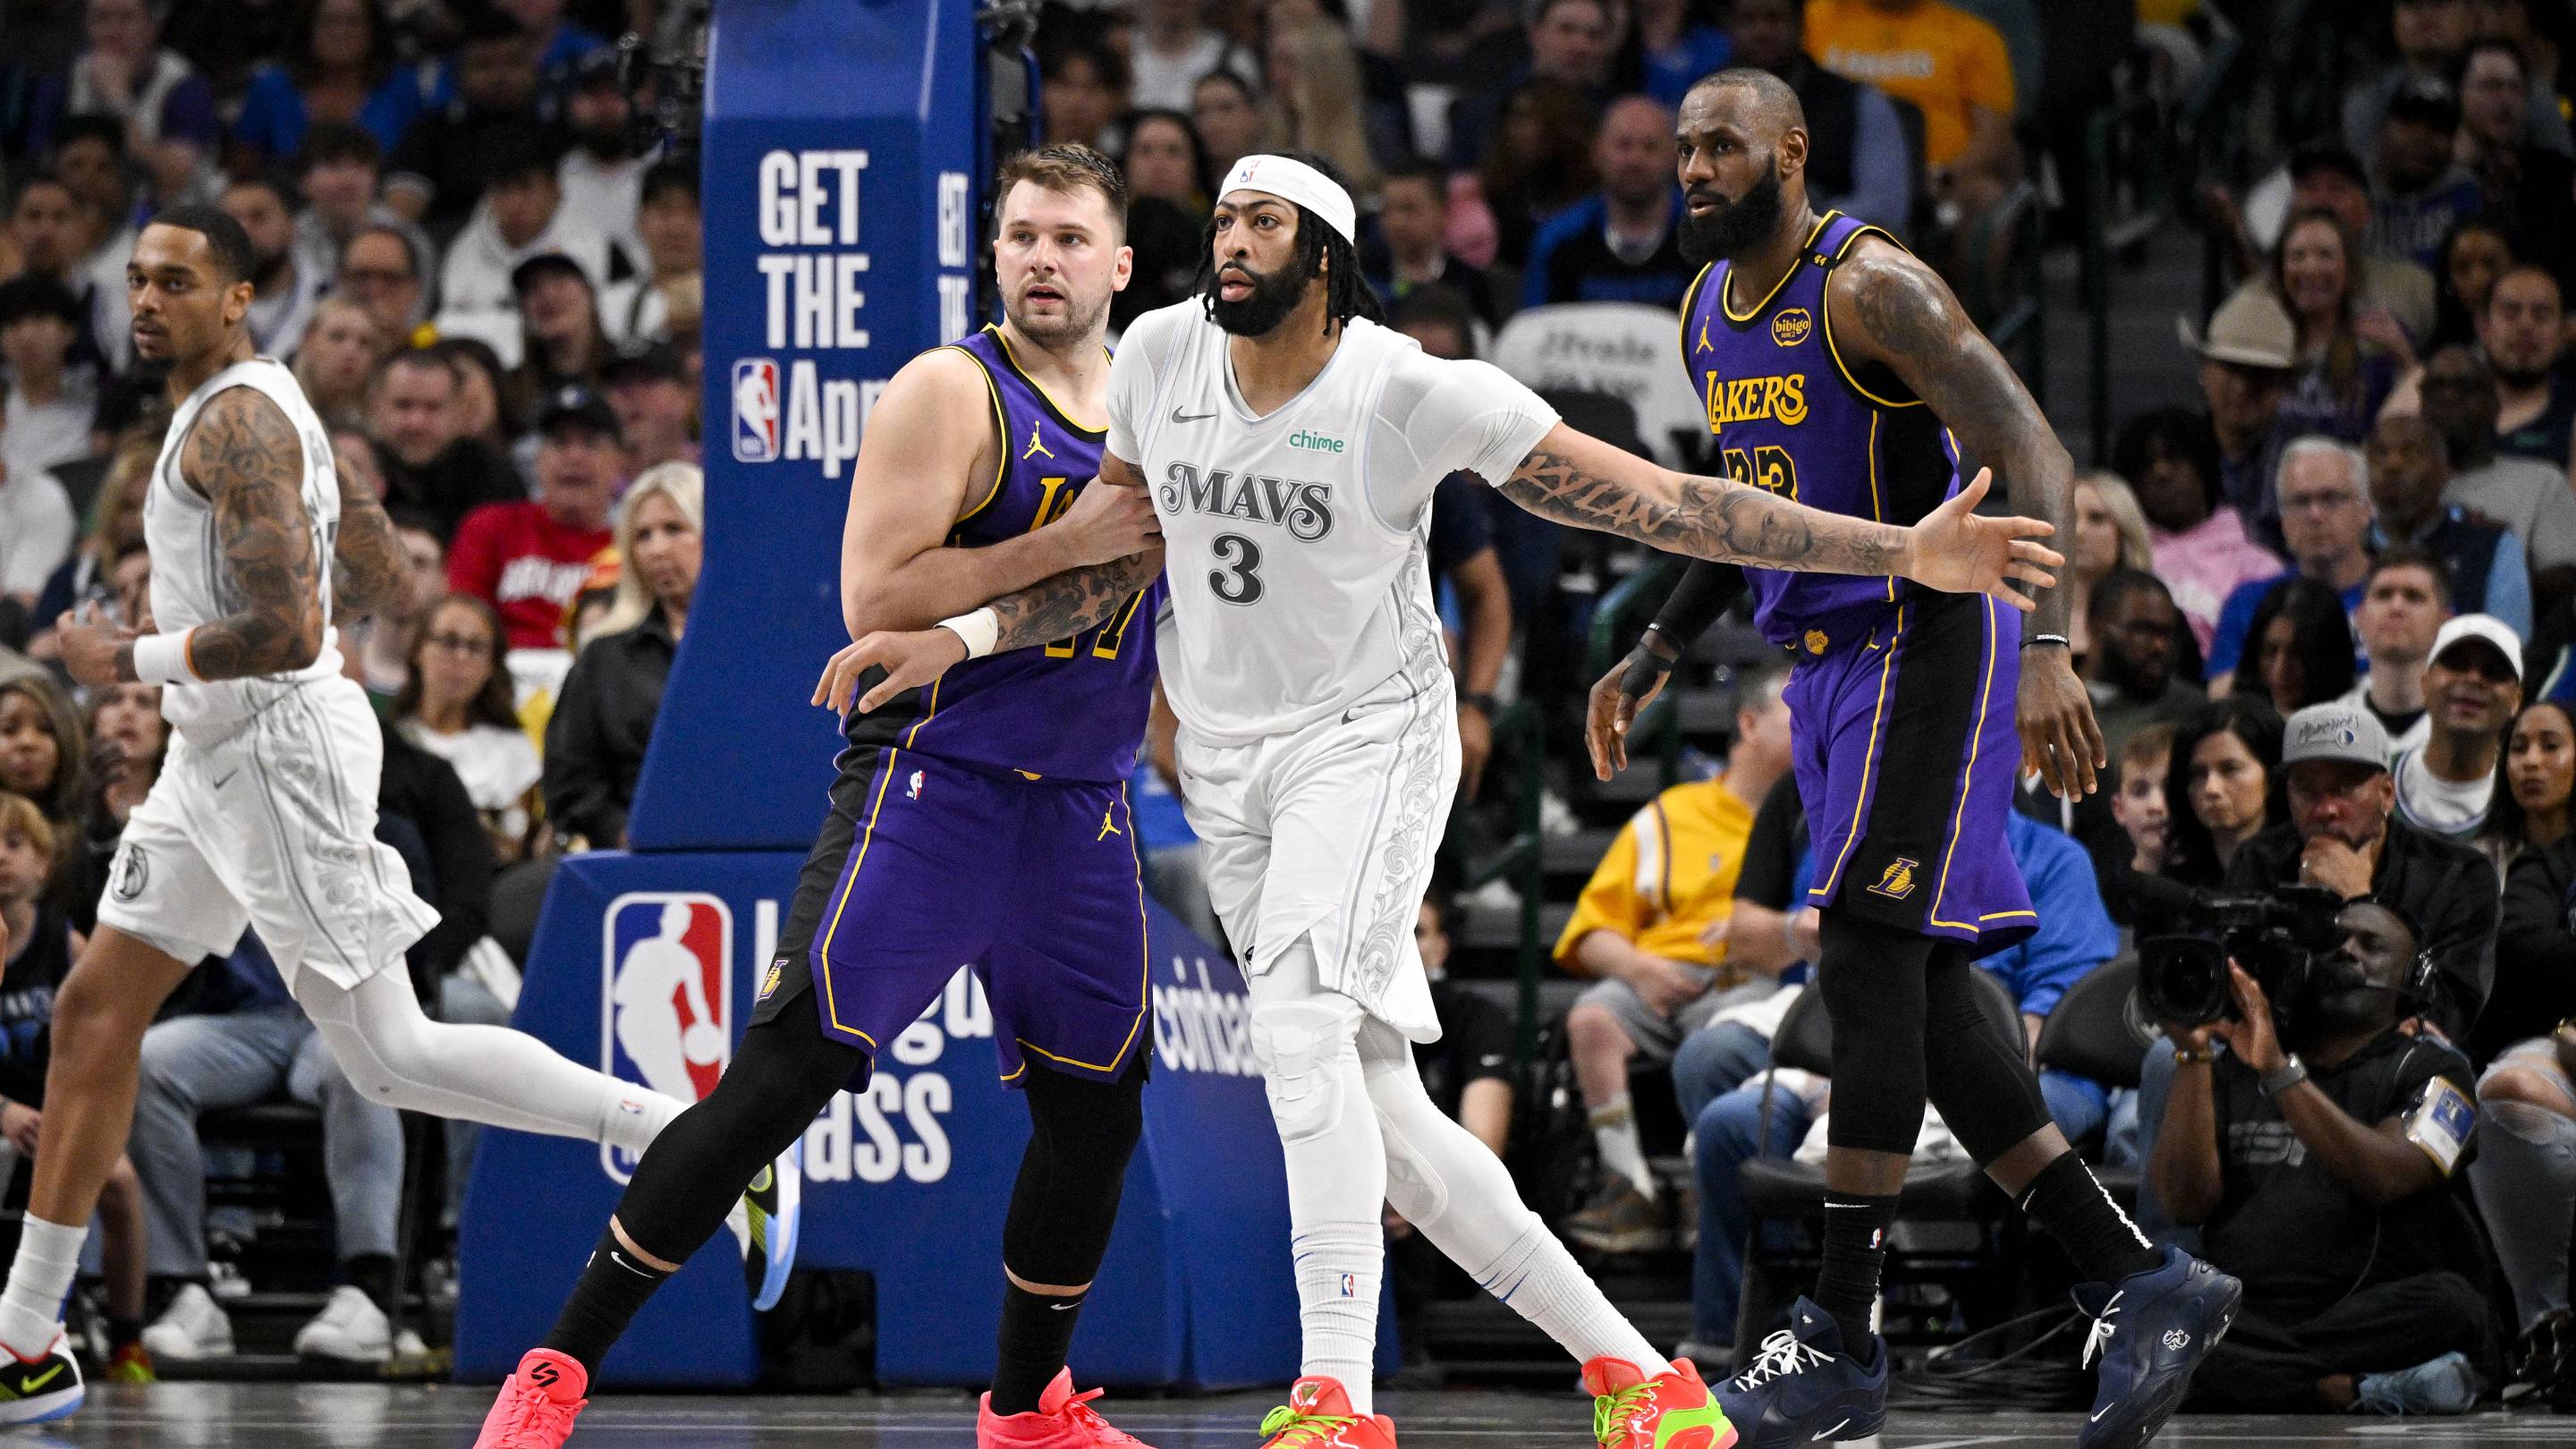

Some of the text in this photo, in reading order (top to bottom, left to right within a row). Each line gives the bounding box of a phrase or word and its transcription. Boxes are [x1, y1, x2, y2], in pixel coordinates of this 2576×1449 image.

[759, 149, 869, 247] GET
[758, 253, 870, 349] THE
[1775, 318, 1809, 334] bibigo
[1706, 369, 1809, 435] LAKERS
[1289, 429, 1344, 453] chime
[1160, 461, 1334, 543] MAVS
[1208, 532, 1265, 606] 3
